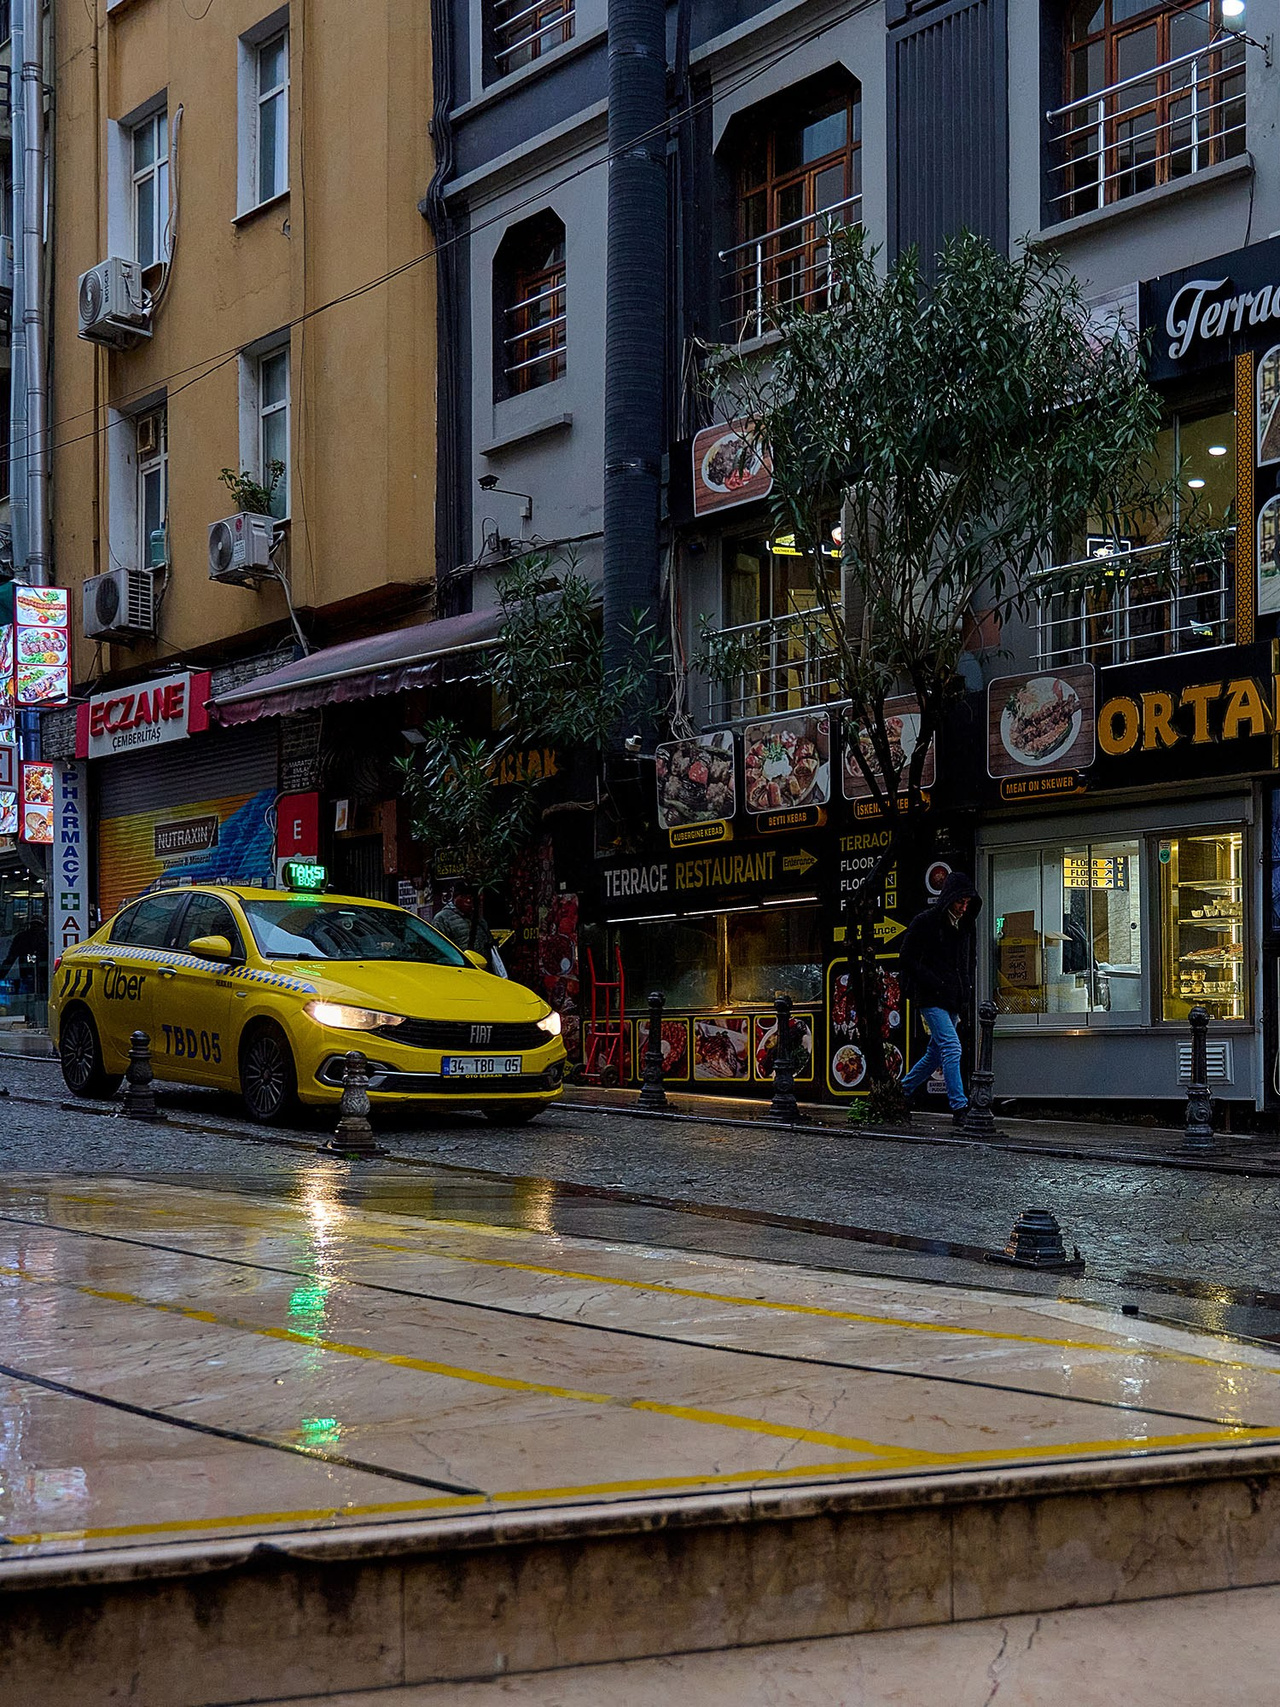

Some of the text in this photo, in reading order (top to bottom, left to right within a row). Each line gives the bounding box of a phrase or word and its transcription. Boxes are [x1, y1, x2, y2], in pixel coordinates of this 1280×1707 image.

[90, 682, 186, 738] ECZANE
[112, 725, 162, 750] ÇEMBERLİTAŞ
[1006, 776, 1074, 794] MEAT ON SKEWER
[787, 812, 807, 824] KEBAB
[62, 772, 80, 888] PHARMACY
[293, 819, 302, 840] E
[673, 826, 723, 842] AUBERGINE KEBAB
[840, 857, 874, 872] FLOOR
[1071, 859, 1099, 867] FLOR
[604, 863, 668, 897] TERRACE
[675, 851, 776, 890] RESTAURANT
[1071, 869, 1099, 877] FLOR
[840, 877, 866, 892] FLO
[1071, 878, 1099, 887] FLOR
[104, 966, 147, 1001] Uber
[470, 1025, 493, 1044] FIAT
[450, 1058, 519, 1073] 34 TBD 05
